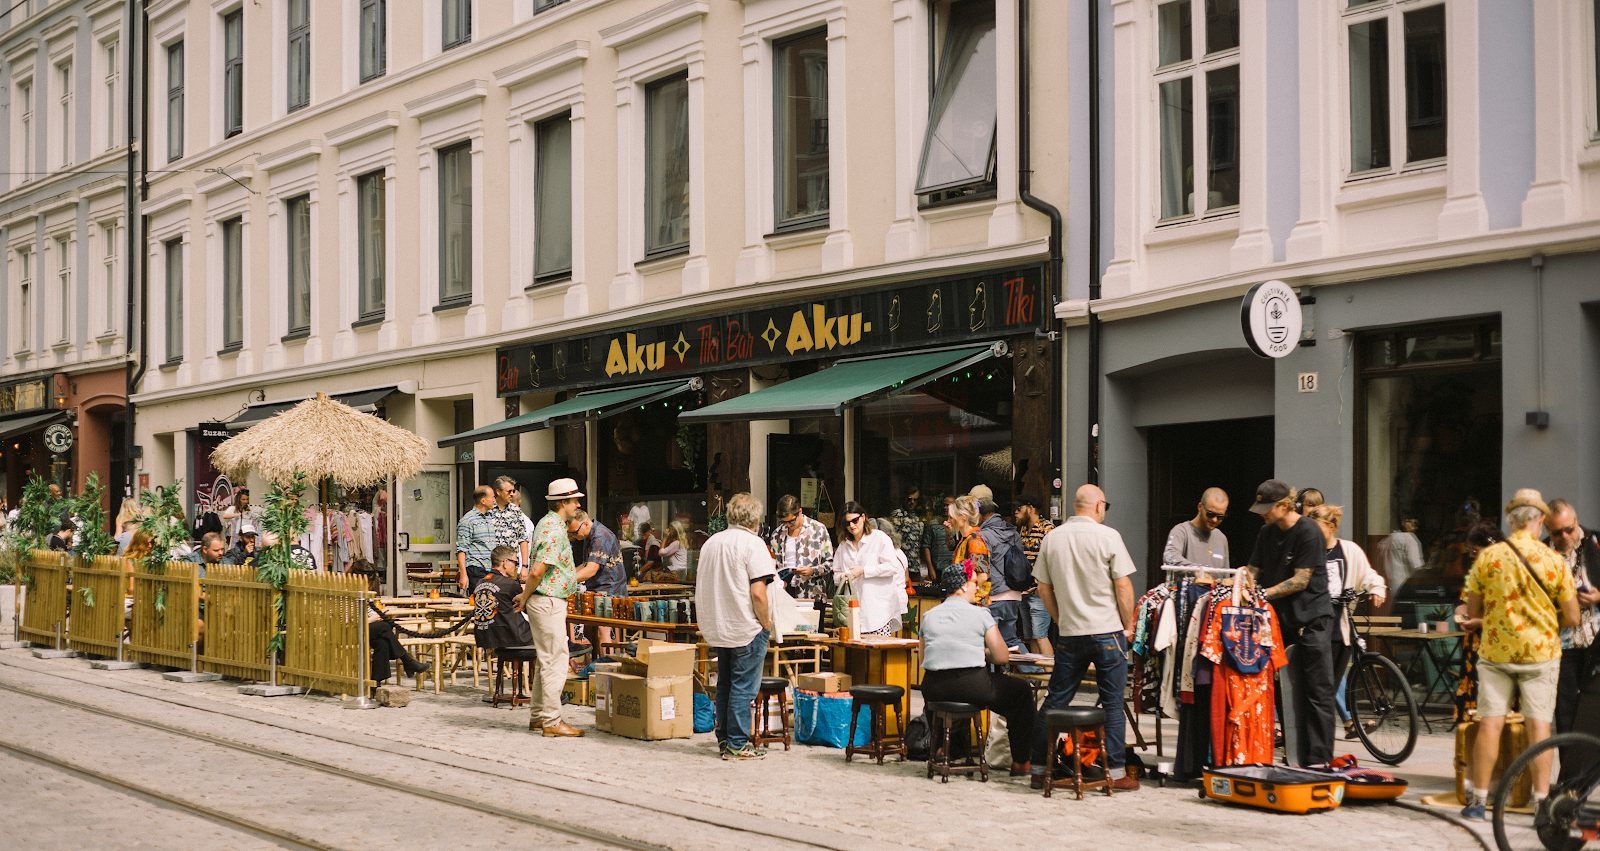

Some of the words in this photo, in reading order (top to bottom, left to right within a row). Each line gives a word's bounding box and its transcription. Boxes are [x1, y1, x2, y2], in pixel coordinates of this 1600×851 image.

[1261, 287, 1290, 305] CULTIVATE
[605, 332, 666, 379] Aku
[697, 323, 721, 365] Tiki
[726, 319, 754, 362] Bar
[1002, 276, 1036, 327] Tiki
[1269, 343, 1288, 353] FOOD
[1300, 374, 1315, 390] 18
[51, 431, 66, 446] G
